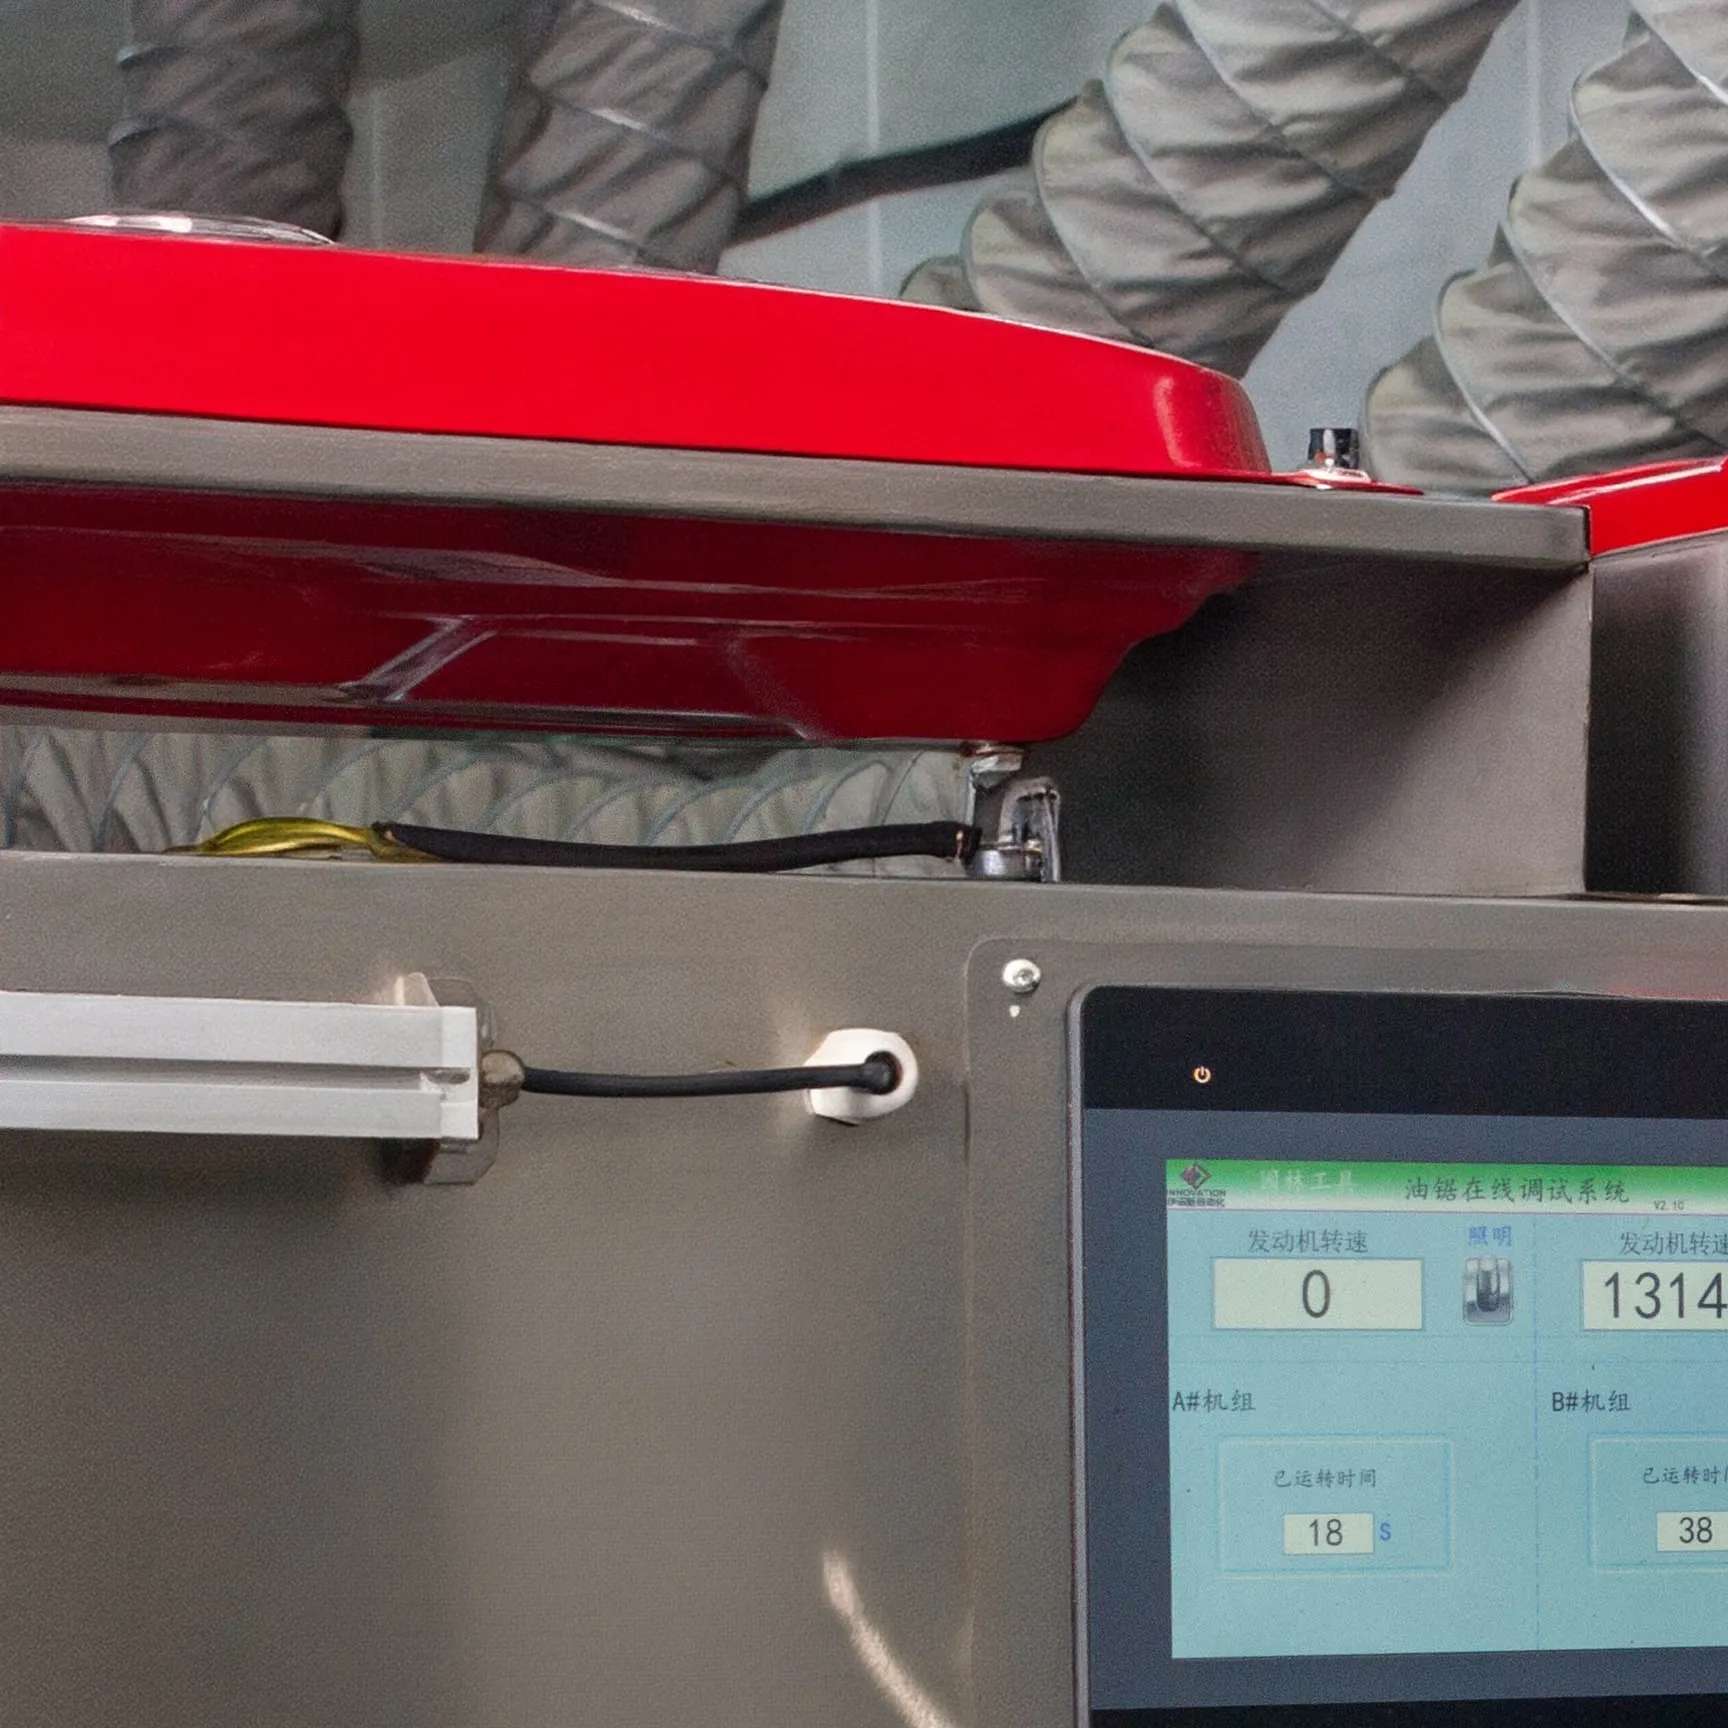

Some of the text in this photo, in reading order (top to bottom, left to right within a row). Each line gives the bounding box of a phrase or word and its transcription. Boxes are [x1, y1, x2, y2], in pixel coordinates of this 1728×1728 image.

[1404, 1176, 1629, 1205] 油锯在线调试系统
[1248, 1229, 1369, 1253] 发动机转速
[1468, 1225, 1513, 1247] 照明
[1302, 1269, 1331, 1319] 0
[1172, 1389, 1256, 1412] A#机组
[1551, 1389, 1631, 1412] B#机组
[1274, 1468, 1377, 1488] 已运转时间
[1309, 1519, 1343, 1546] 18
[1679, 1516, 1713, 1543] 38
